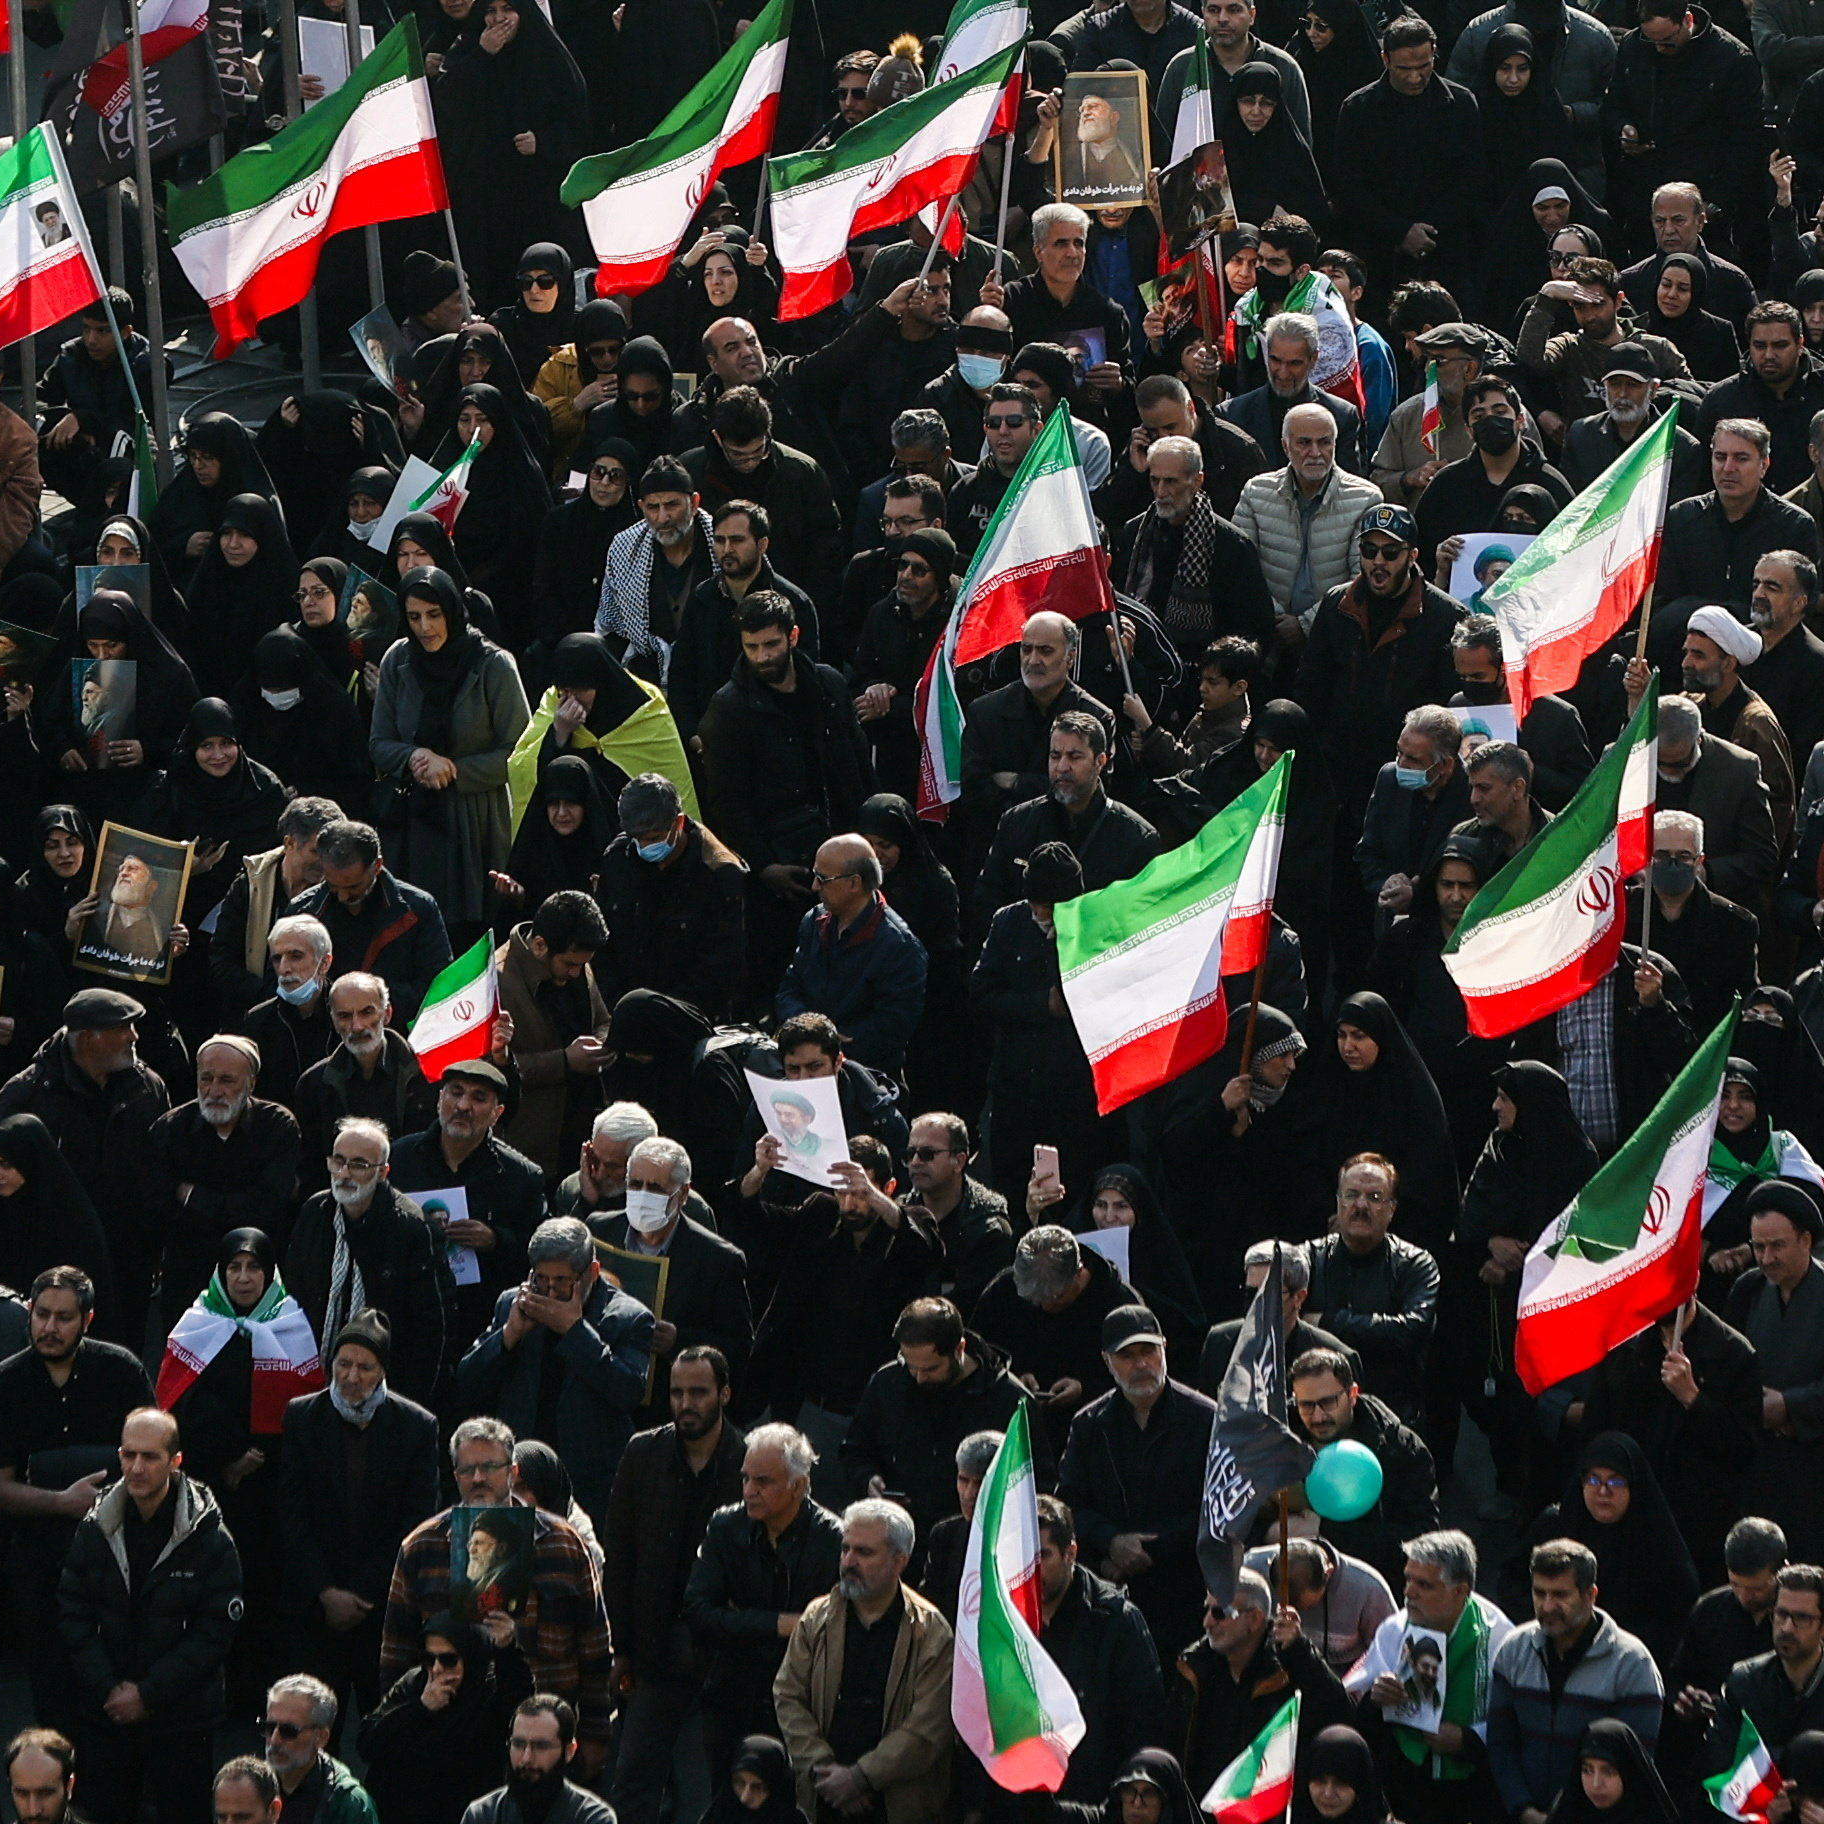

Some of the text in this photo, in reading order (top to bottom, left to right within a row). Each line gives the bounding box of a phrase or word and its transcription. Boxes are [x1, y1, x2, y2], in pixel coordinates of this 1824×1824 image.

[1062, 187, 1079, 198] دادی
[1079, 184, 1102, 197] طوفان
[78, 944, 97, 955] دادی
[96, 949, 120, 963] طوفان
